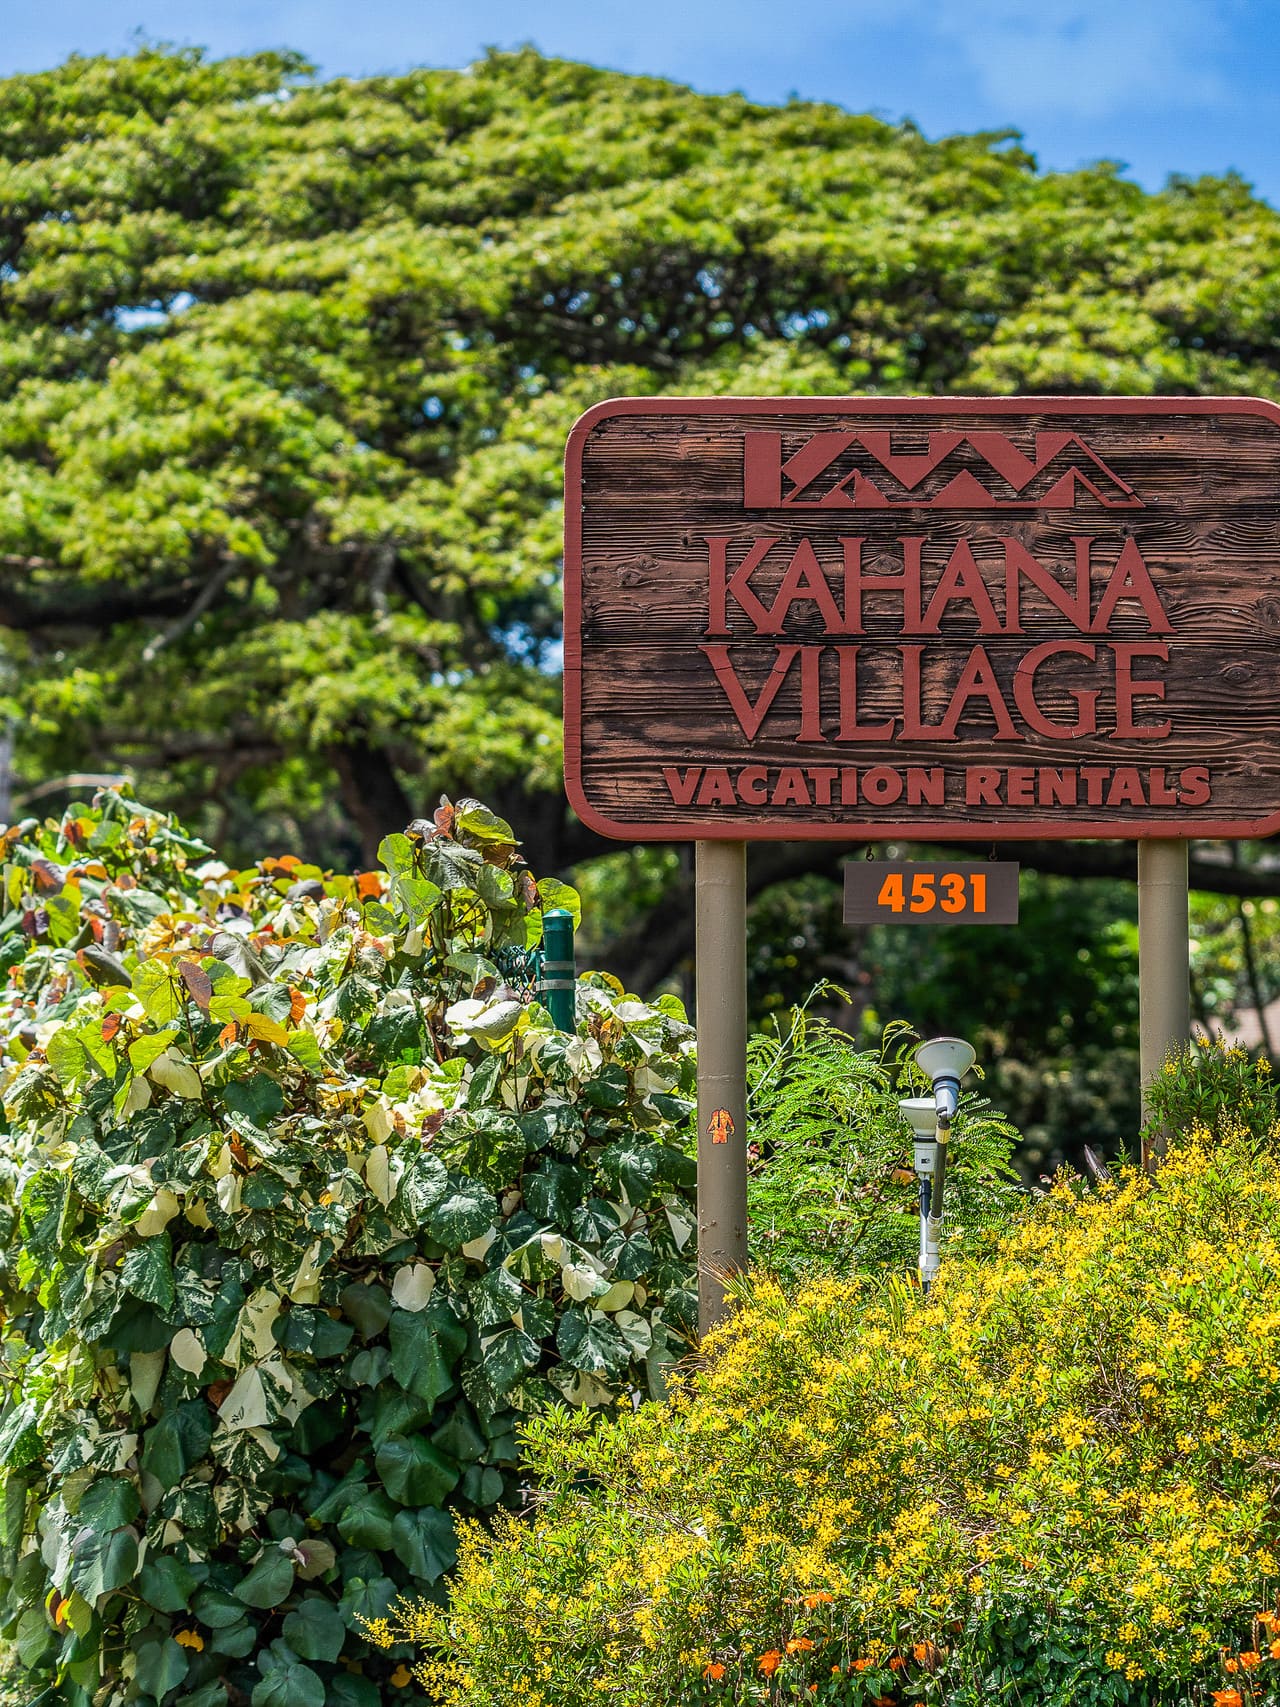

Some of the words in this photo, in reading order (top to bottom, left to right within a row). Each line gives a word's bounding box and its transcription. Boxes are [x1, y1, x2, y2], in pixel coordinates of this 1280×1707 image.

[704, 536, 1175, 634] KAHANA
[700, 641, 1173, 742] VILLAGE
[663, 766, 944, 806] VACATION
[965, 766, 1212, 806] RENTALS
[877, 873, 987, 913] 4531
